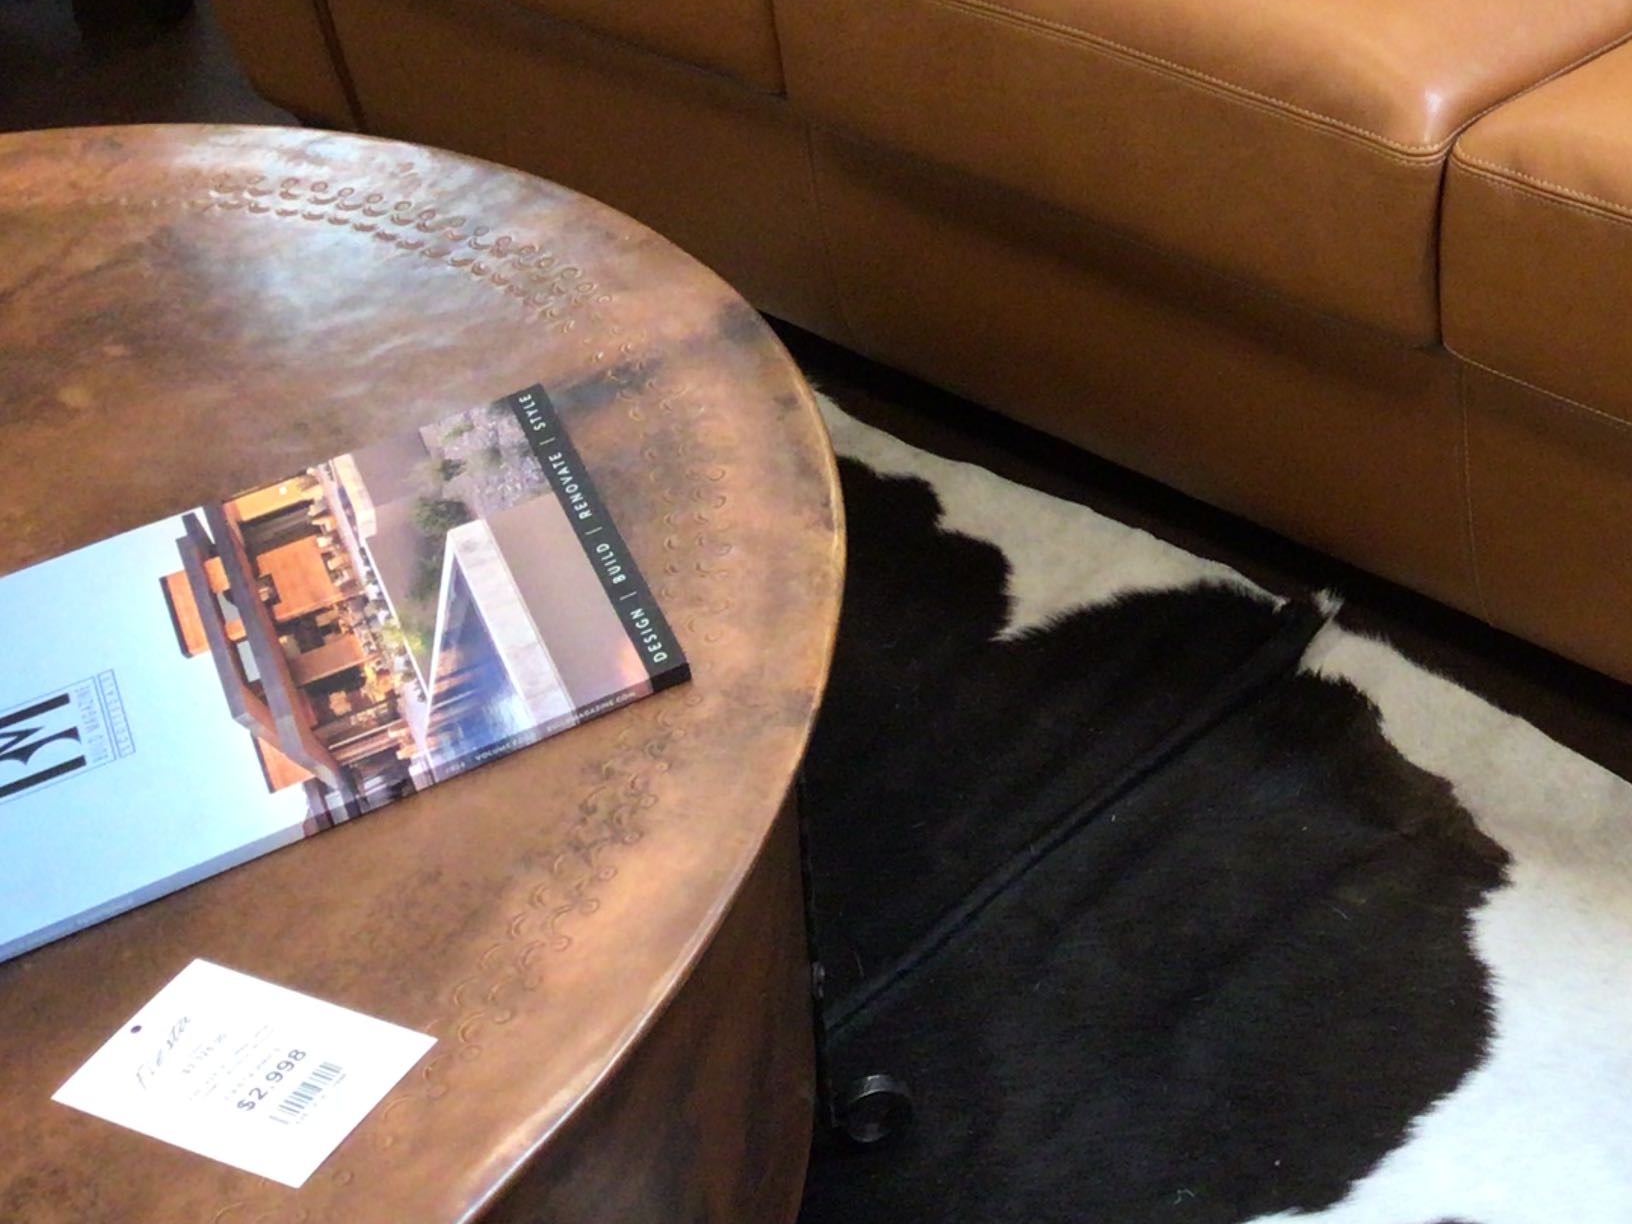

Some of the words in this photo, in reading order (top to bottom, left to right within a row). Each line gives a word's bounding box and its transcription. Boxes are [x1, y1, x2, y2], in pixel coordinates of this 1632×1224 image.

[518, 393, 546, 431] STYLE
[548, 451, 593, 520] RENOVATE
[595, 543, 627, 584] BUILD
[629, 607, 668, 663] DESIGN
